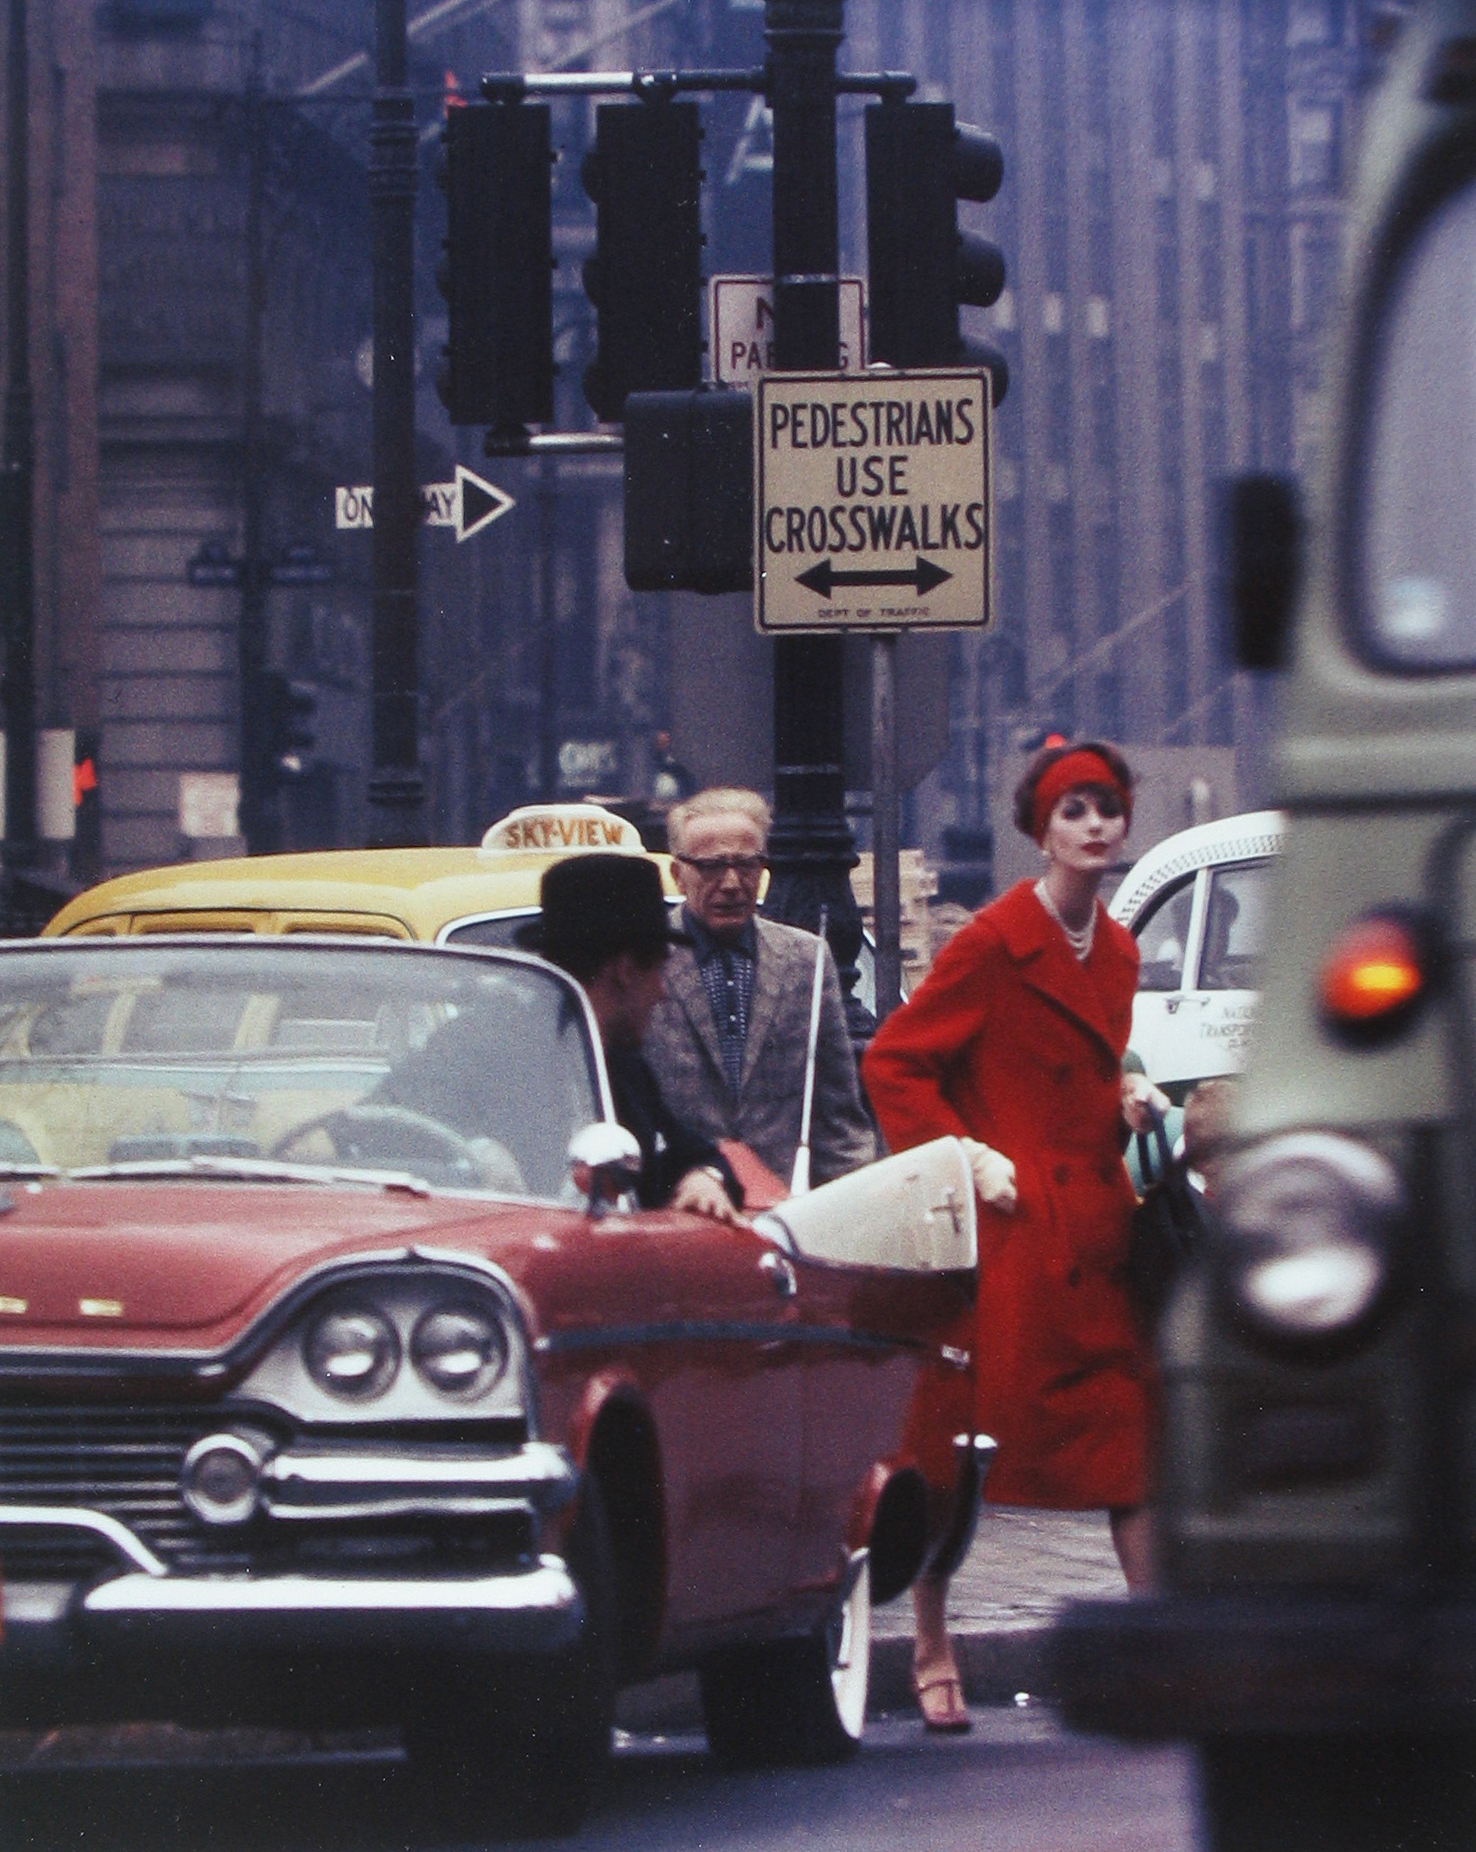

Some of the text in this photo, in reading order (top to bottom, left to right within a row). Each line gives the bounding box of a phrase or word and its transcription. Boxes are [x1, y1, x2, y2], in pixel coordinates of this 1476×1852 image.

[771, 398, 975, 449] PEDESTRIANS
[836, 455, 909, 498] USE
[344, 493, 374, 524] ON
[765, 502, 985, 553] CROSSWALKS
